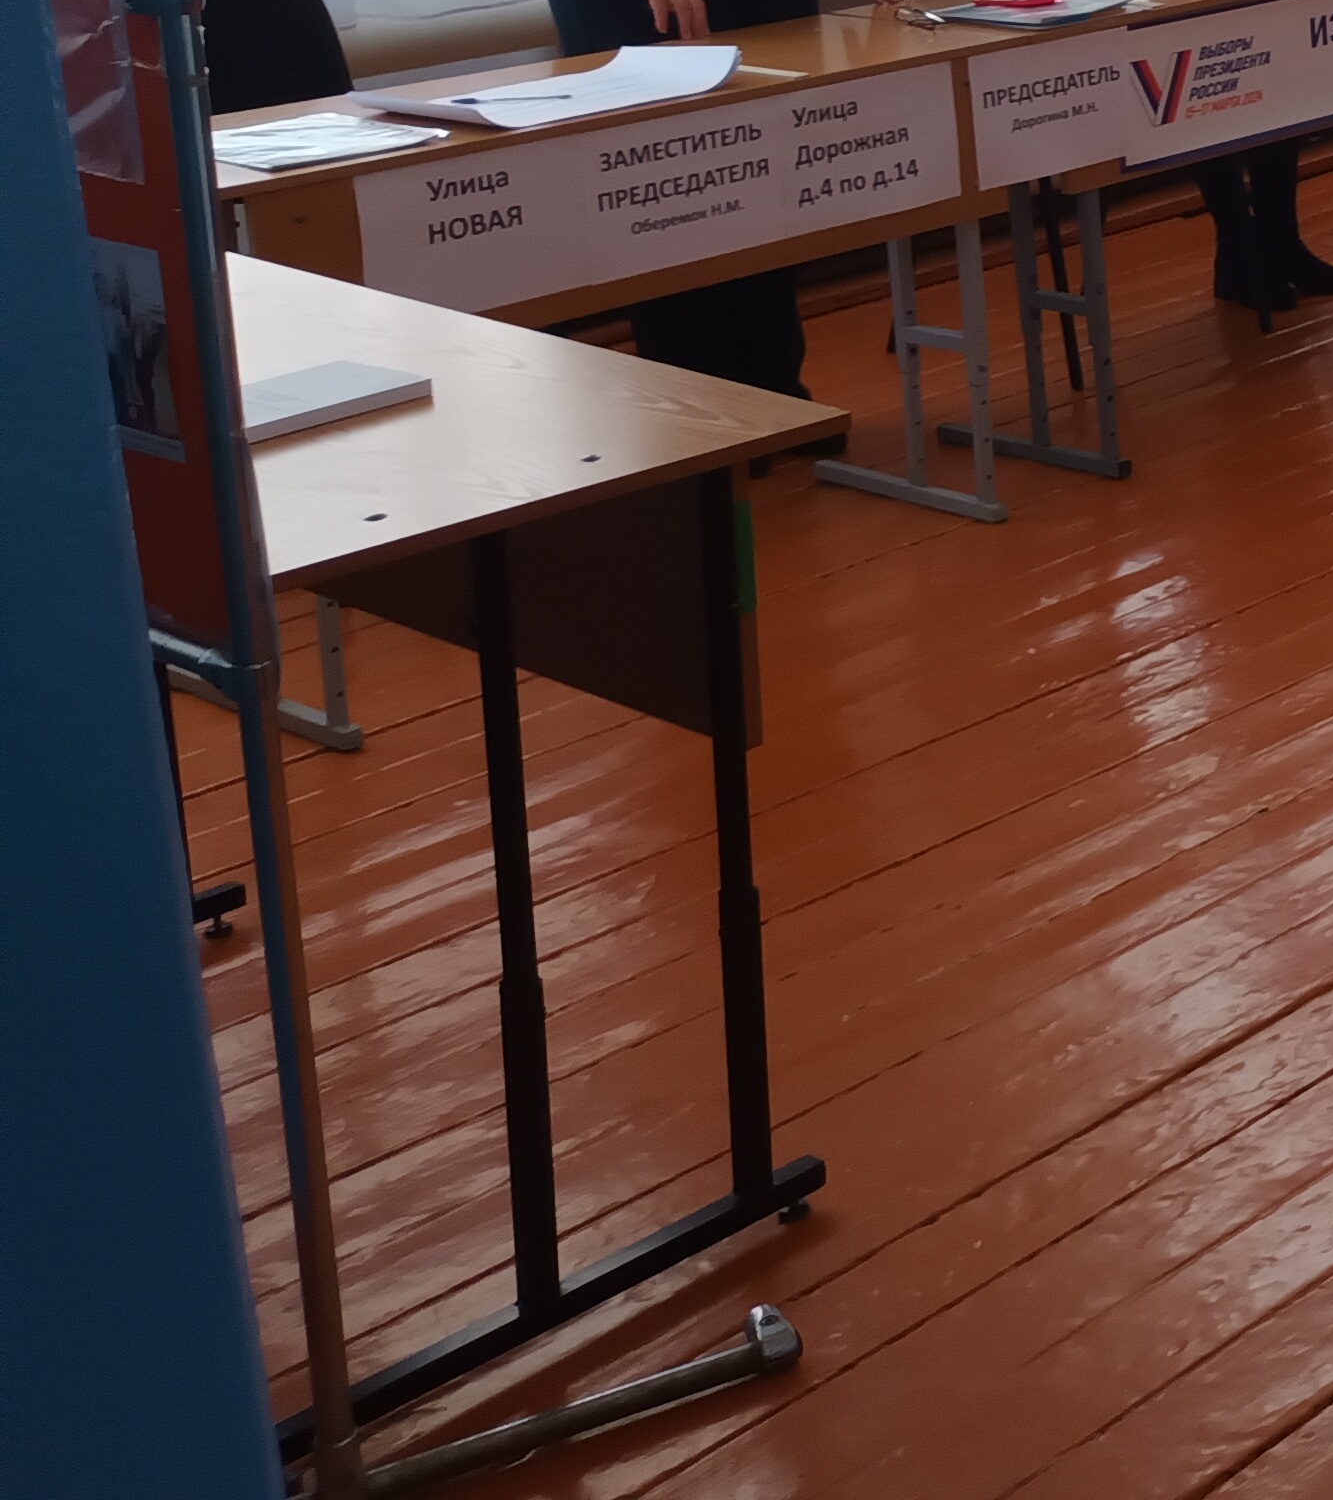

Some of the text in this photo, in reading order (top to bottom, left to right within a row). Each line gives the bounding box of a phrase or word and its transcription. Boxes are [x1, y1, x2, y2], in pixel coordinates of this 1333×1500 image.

[1193, 51, 1272, 81] ПРЕЗИДЕНТА
[1198, 35, 1255, 61] ВЫБОРЫ
[982, 65, 1121, 109] ПРЕДСЕДАТЕЛЬ
[1189, 78, 1239, 101] РОССИИ
[792, 101, 858, 128] Улица
[598, 123, 762, 172] ЗАМЕСТИТЕЛЬ
[795, 127, 910, 170] Дорожная
[426, 171, 509, 202] Улица
[597, 158, 770, 212] ПРЕДСЕДАТЕЛЯ
[798, 159, 919, 208] д.4 по д.14
[428, 205, 523, 244] НОВАЯ
